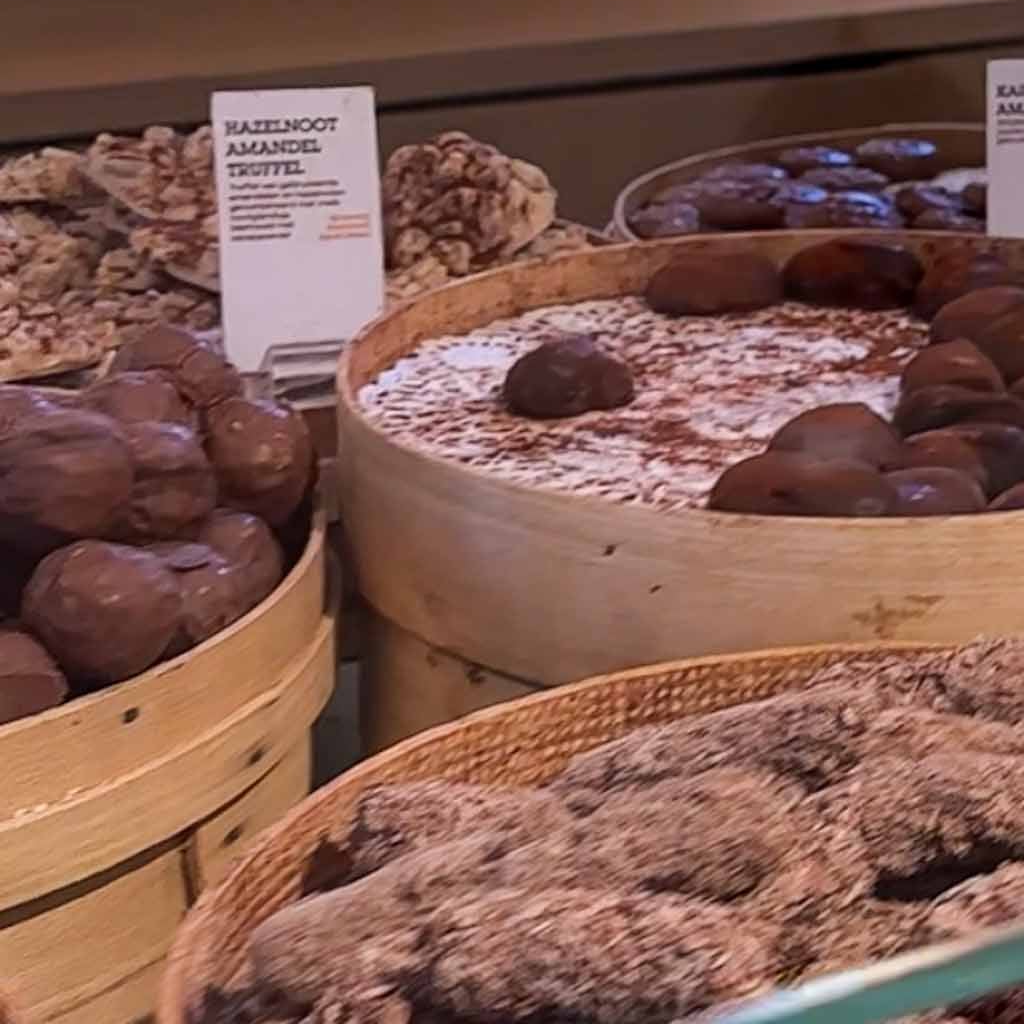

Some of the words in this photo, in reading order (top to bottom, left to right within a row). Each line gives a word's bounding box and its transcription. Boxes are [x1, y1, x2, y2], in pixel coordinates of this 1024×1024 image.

[225, 117, 339, 136] HAZELNOOT
[225, 139, 322, 157] AMANDEL
[226, 160, 306, 177] TRUFFEL
